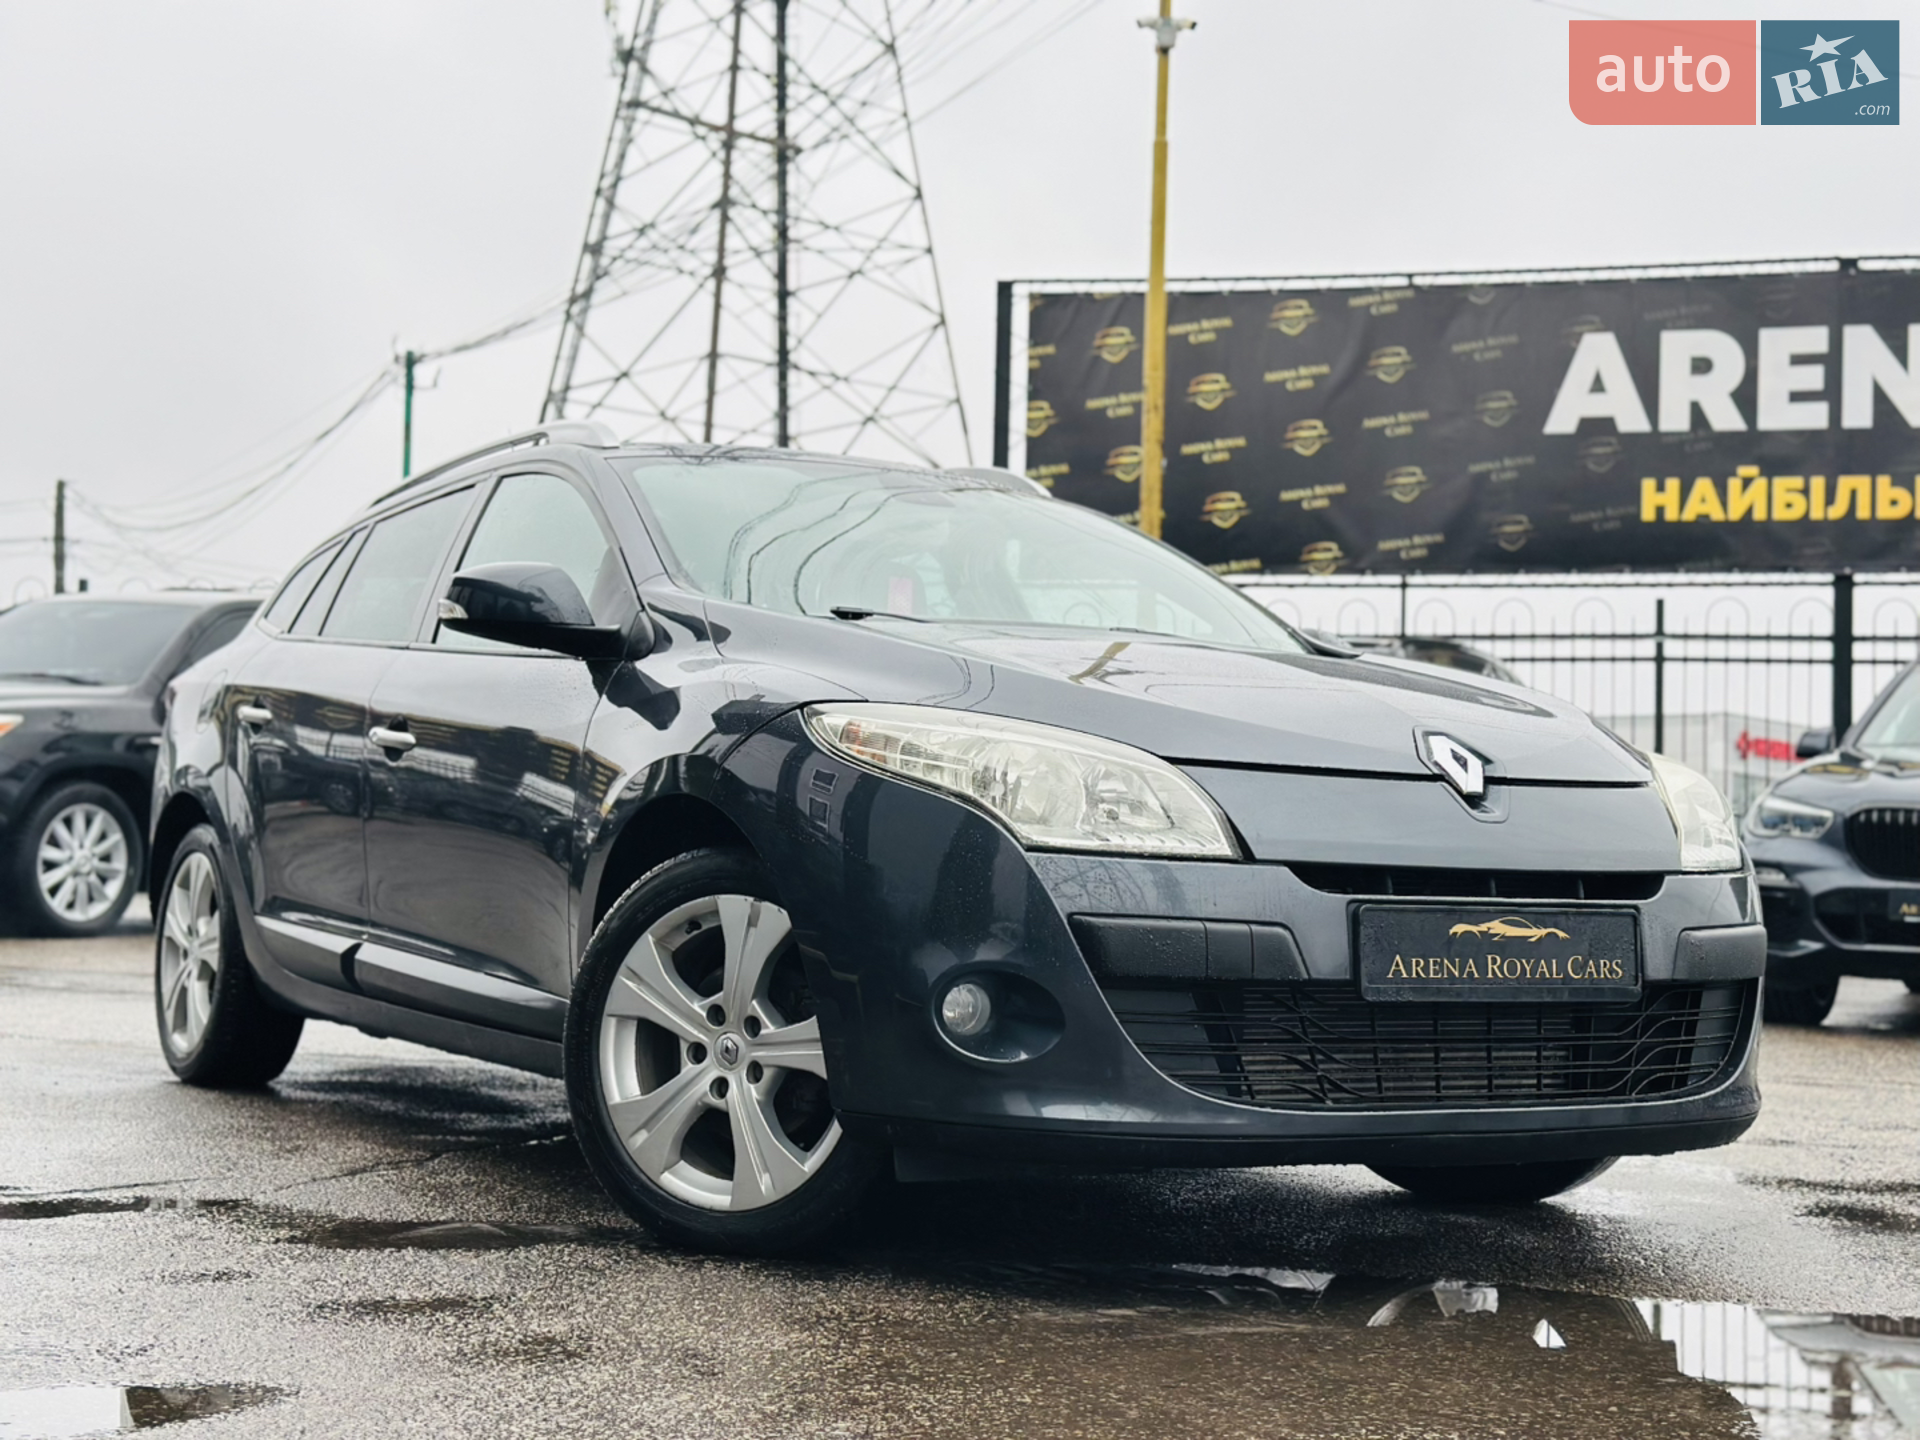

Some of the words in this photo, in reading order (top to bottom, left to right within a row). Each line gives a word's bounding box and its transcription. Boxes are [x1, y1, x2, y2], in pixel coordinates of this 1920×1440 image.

[1542, 323, 1920, 435] AREN
[1639, 465, 1920, 522] НАЙБІЛЬ
[1386, 954, 1480, 979] ARENA
[1486, 954, 1564, 979] ROYAL
[1567, 955, 1624, 980] CARS
